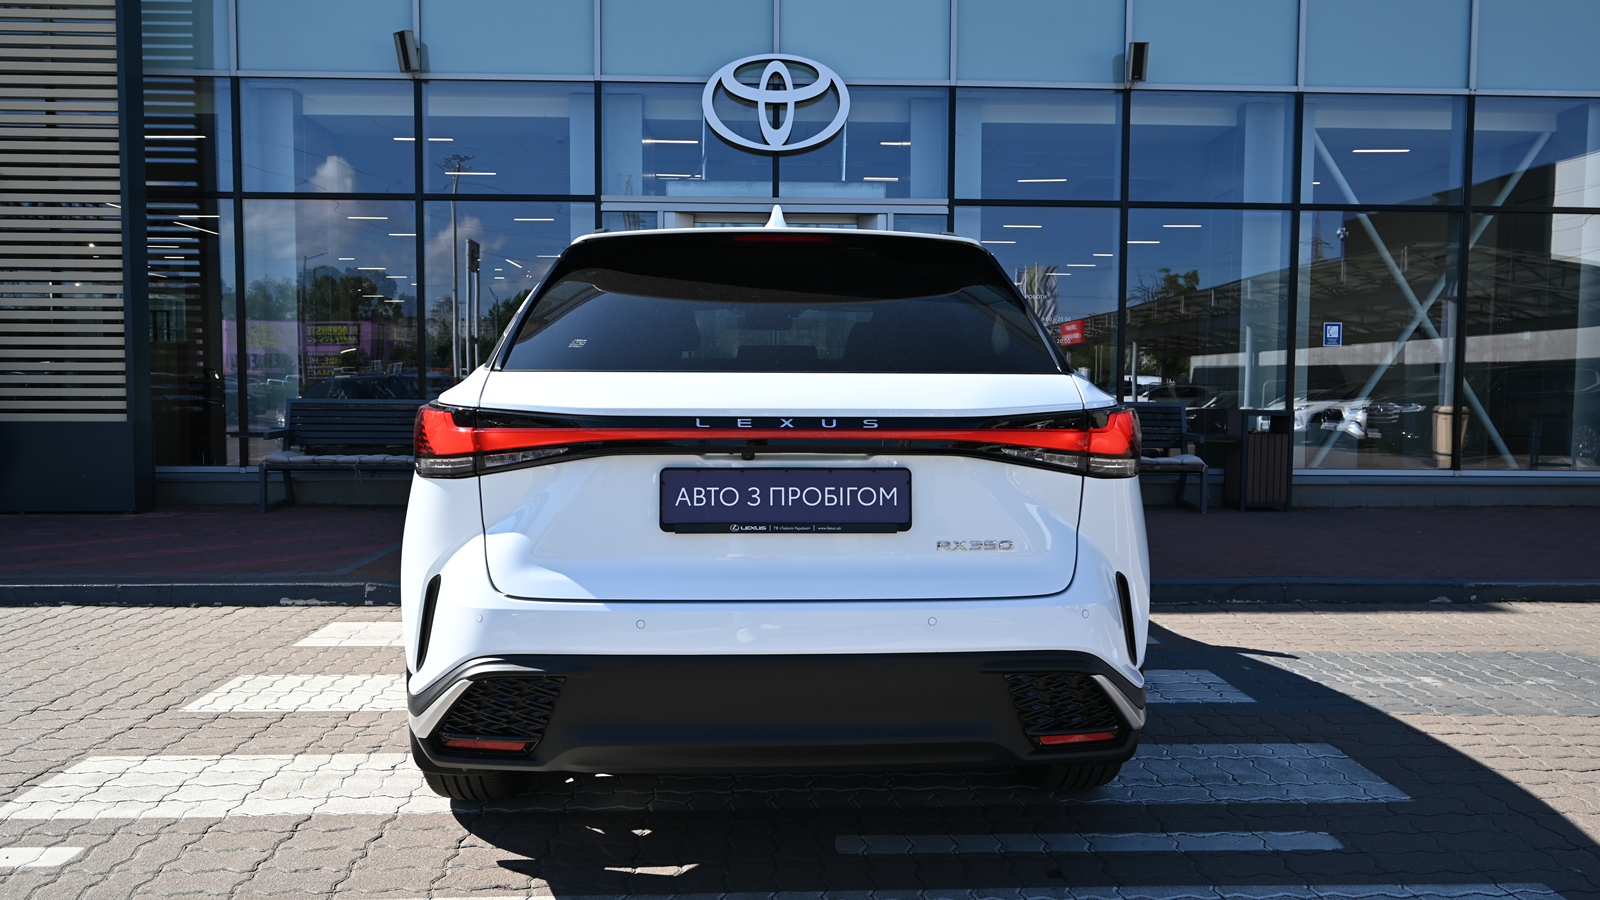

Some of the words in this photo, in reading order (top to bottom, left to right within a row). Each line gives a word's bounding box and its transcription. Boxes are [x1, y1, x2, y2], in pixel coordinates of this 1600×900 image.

[695, 418, 879, 428] LEXUS
[675, 487, 740, 507] АВТО
[747, 487, 761, 507] З
[769, 487, 898, 507] ПРОБІГОМ
[936, 540, 1014, 552] RX350
